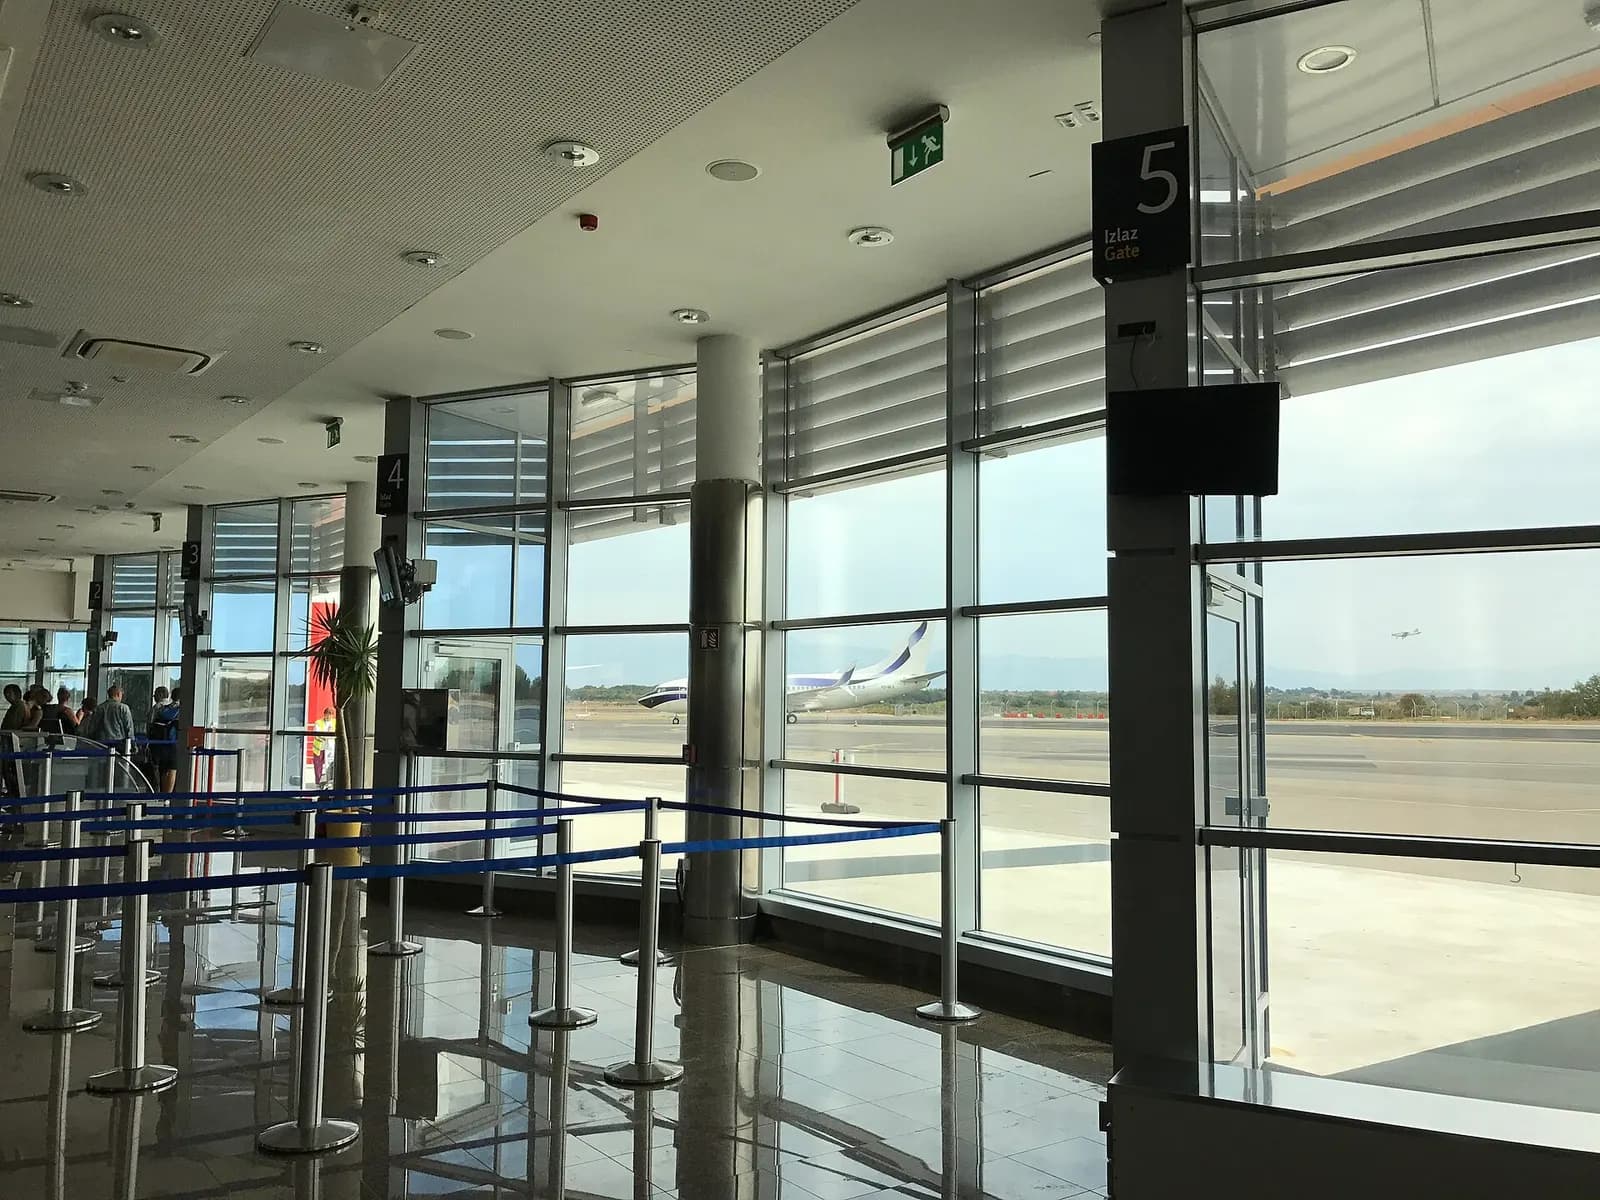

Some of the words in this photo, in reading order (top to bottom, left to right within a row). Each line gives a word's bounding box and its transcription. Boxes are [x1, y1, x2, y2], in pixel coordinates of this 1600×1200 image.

[1136, 141, 1178, 214] 5
[1104, 227, 1138, 244] Izlaz
[1104, 245, 1140, 261] Gate
[387, 458, 404, 489] 4
[190, 544, 199, 564] 3
[95, 583, 101, 599] 2
